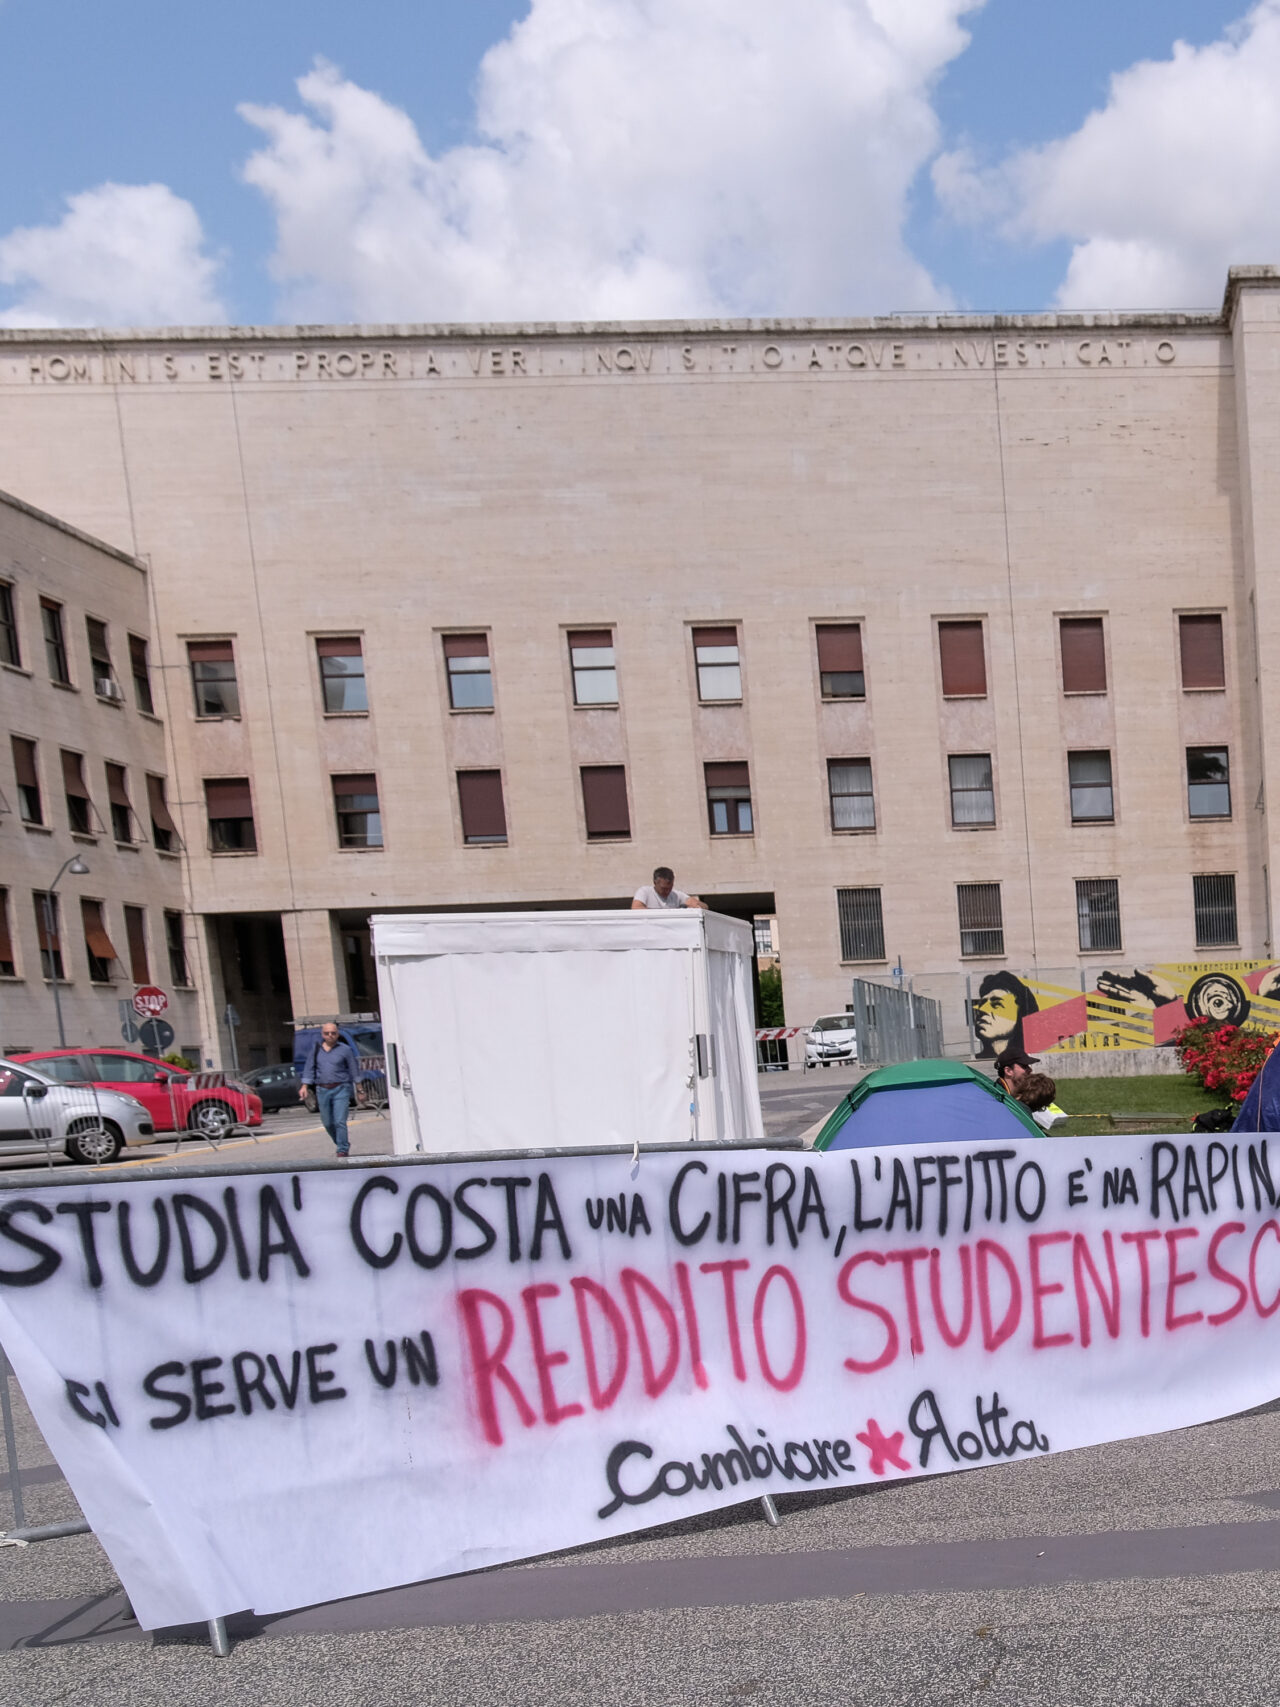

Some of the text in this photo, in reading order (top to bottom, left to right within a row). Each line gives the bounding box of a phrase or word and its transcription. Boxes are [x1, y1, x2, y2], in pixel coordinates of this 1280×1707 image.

[26, 353, 179, 383] HOMINIS
[208, 353, 265, 381] EST
[295, 351, 441, 379] PROPRIA
[467, 348, 543, 376] VERI
[575, 344, 783, 374] INQVISITIO
[808, 343, 907, 370] ATQVE
[135, 995, 166, 1009] STOP
[0, 1176, 311, 1288] STUDIA'
[350, 1172, 572, 1269] COSTA
[587, 1192, 652, 1236] UNA
[669, 1160, 848, 1257] CIFRA,
[851, 1149, 1047, 1235] L'AFFITTO
[1102, 1165, 1138, 1206] NA
[64, 1379, 120, 1429] CI
[143, 1343, 347, 1430] SERVE
[365, 1331, 440, 1387] UN
[457, 1260, 807, 1447] REDDITO
[597, 1425, 856, 1520] Cambiare
